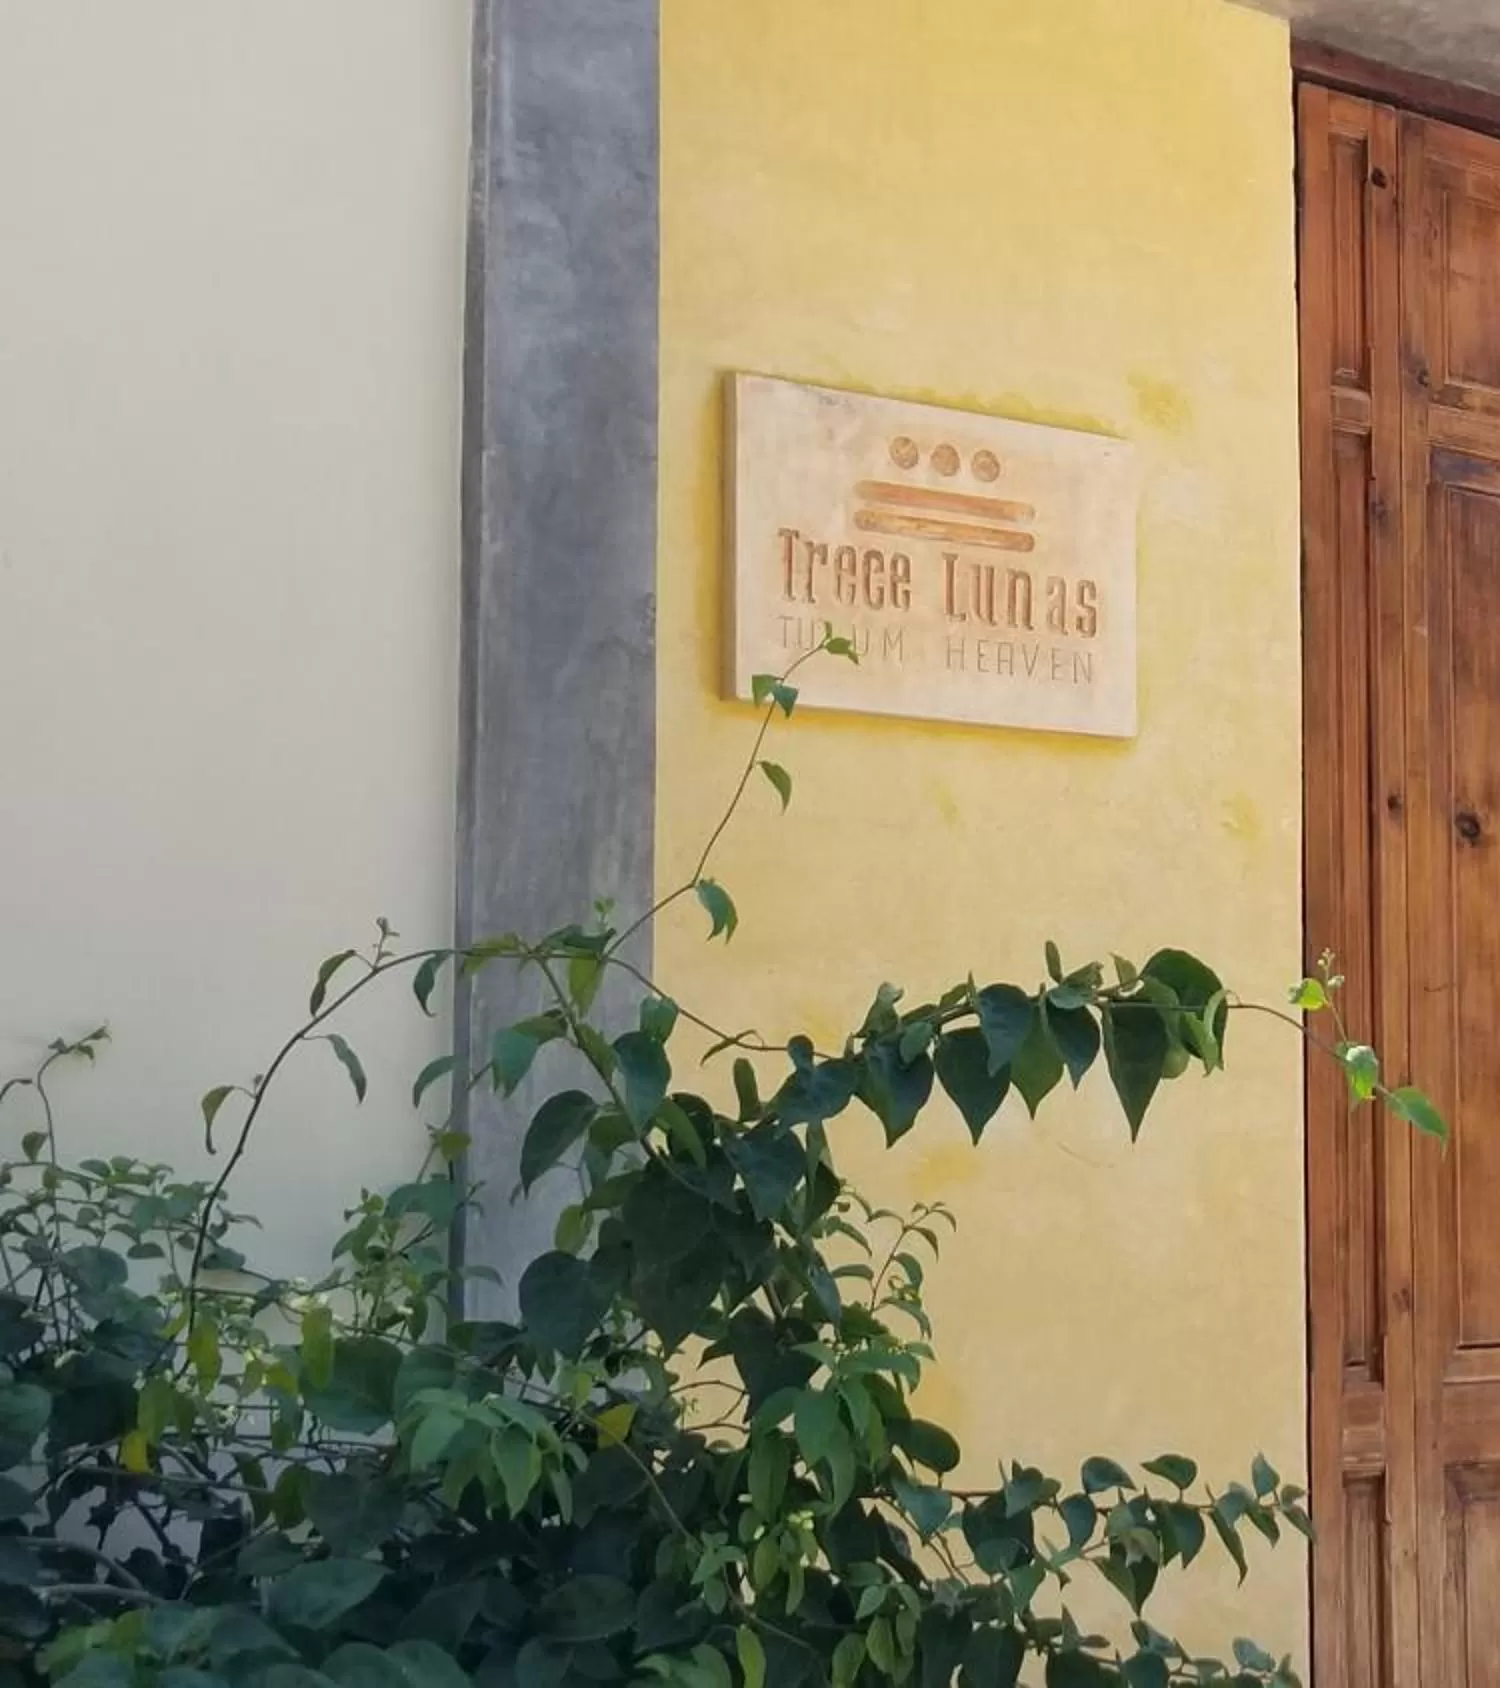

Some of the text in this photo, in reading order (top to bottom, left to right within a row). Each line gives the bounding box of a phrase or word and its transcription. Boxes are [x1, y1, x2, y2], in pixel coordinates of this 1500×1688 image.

[778, 528, 1097, 638] Trece Lunas
[778, 615, 1094, 684] TUUM HEAVEN
